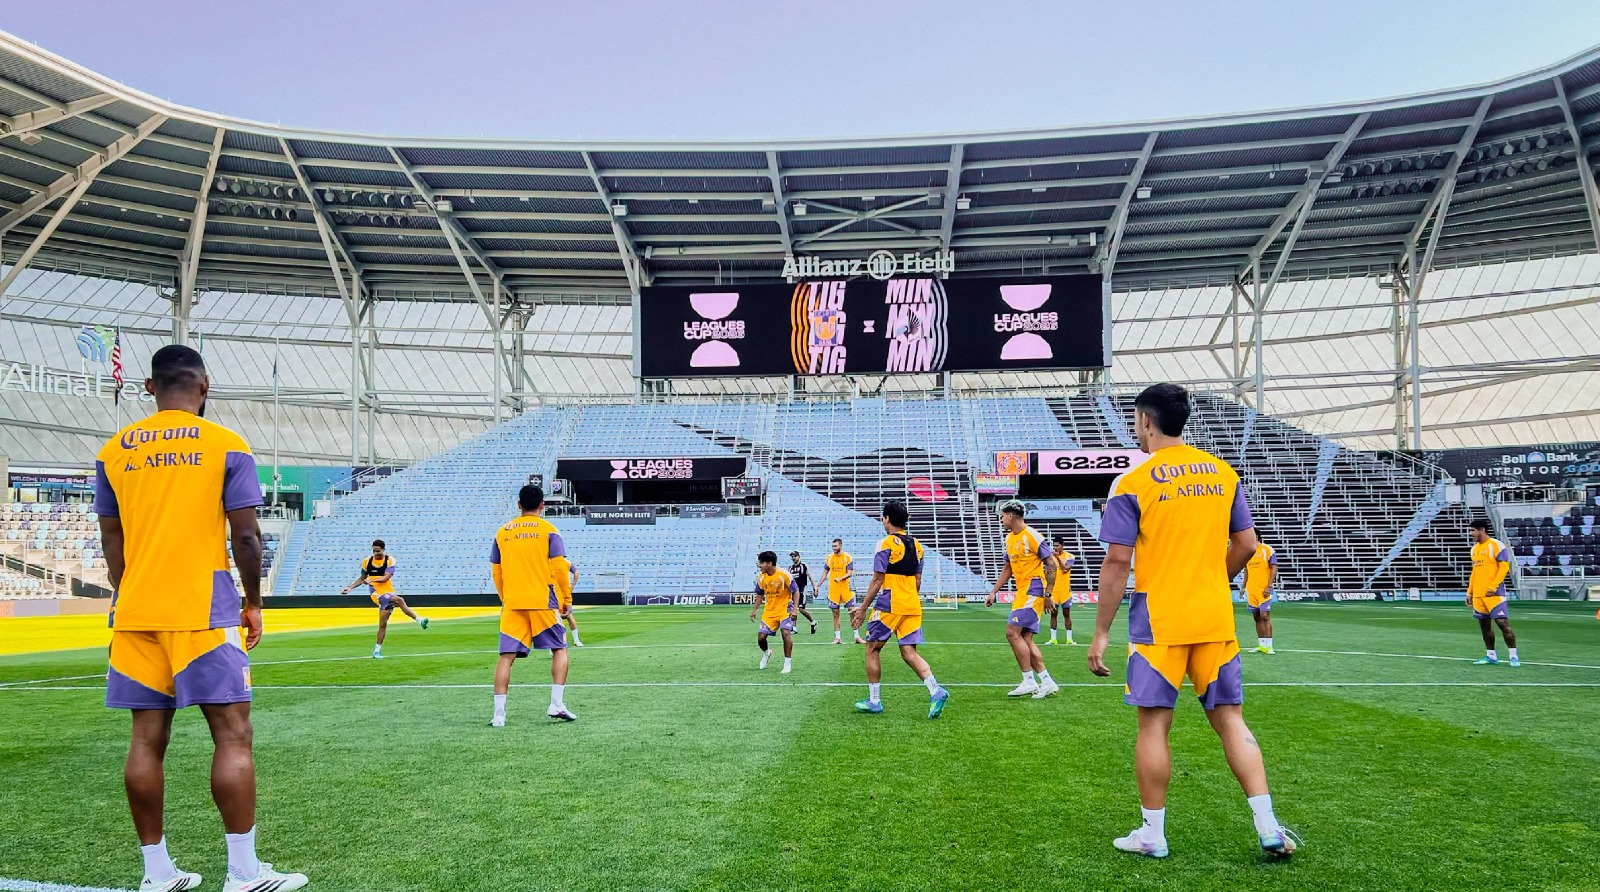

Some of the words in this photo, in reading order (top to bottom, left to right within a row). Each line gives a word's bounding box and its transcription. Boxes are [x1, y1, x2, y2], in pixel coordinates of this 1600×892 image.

[781, 255, 862, 278] Allianz
[903, 251, 955, 274] Field
[807, 281, 846, 311] TIG
[885, 278, 932, 304] MIN
[994, 312, 1058, 324] LEAGUES
[683, 320, 746, 331] LEAGUES
[994, 322, 1023, 332] CUP
[683, 330, 712, 340] CUP
[807, 345, 847, 374] TIG
[885, 338, 932, 371] MIN
[1, 363, 94, 397] Allina
[120, 426, 200, 451] Corona
[144, 452, 203, 468] AFIRME
[628, 459, 693, 470] LEAGUES
[1055, 455, 1130, 470] 62:28
[1502, 454, 1526, 464] Bell
[1546, 452, 1579, 462] Bank
[628, 469, 658, 479] CUP
[1150, 462, 1219, 484] Corona
[1466, 468, 1523, 478] UNITED
[1529, 466, 1560, 474] FOR
[1176, 484, 1225, 498] AFIRME
[685, 505, 722, 513] #SaveTheCup
[1063, 504, 1089, 512] CLOUDS
[514, 532, 540, 540] AFIRME
